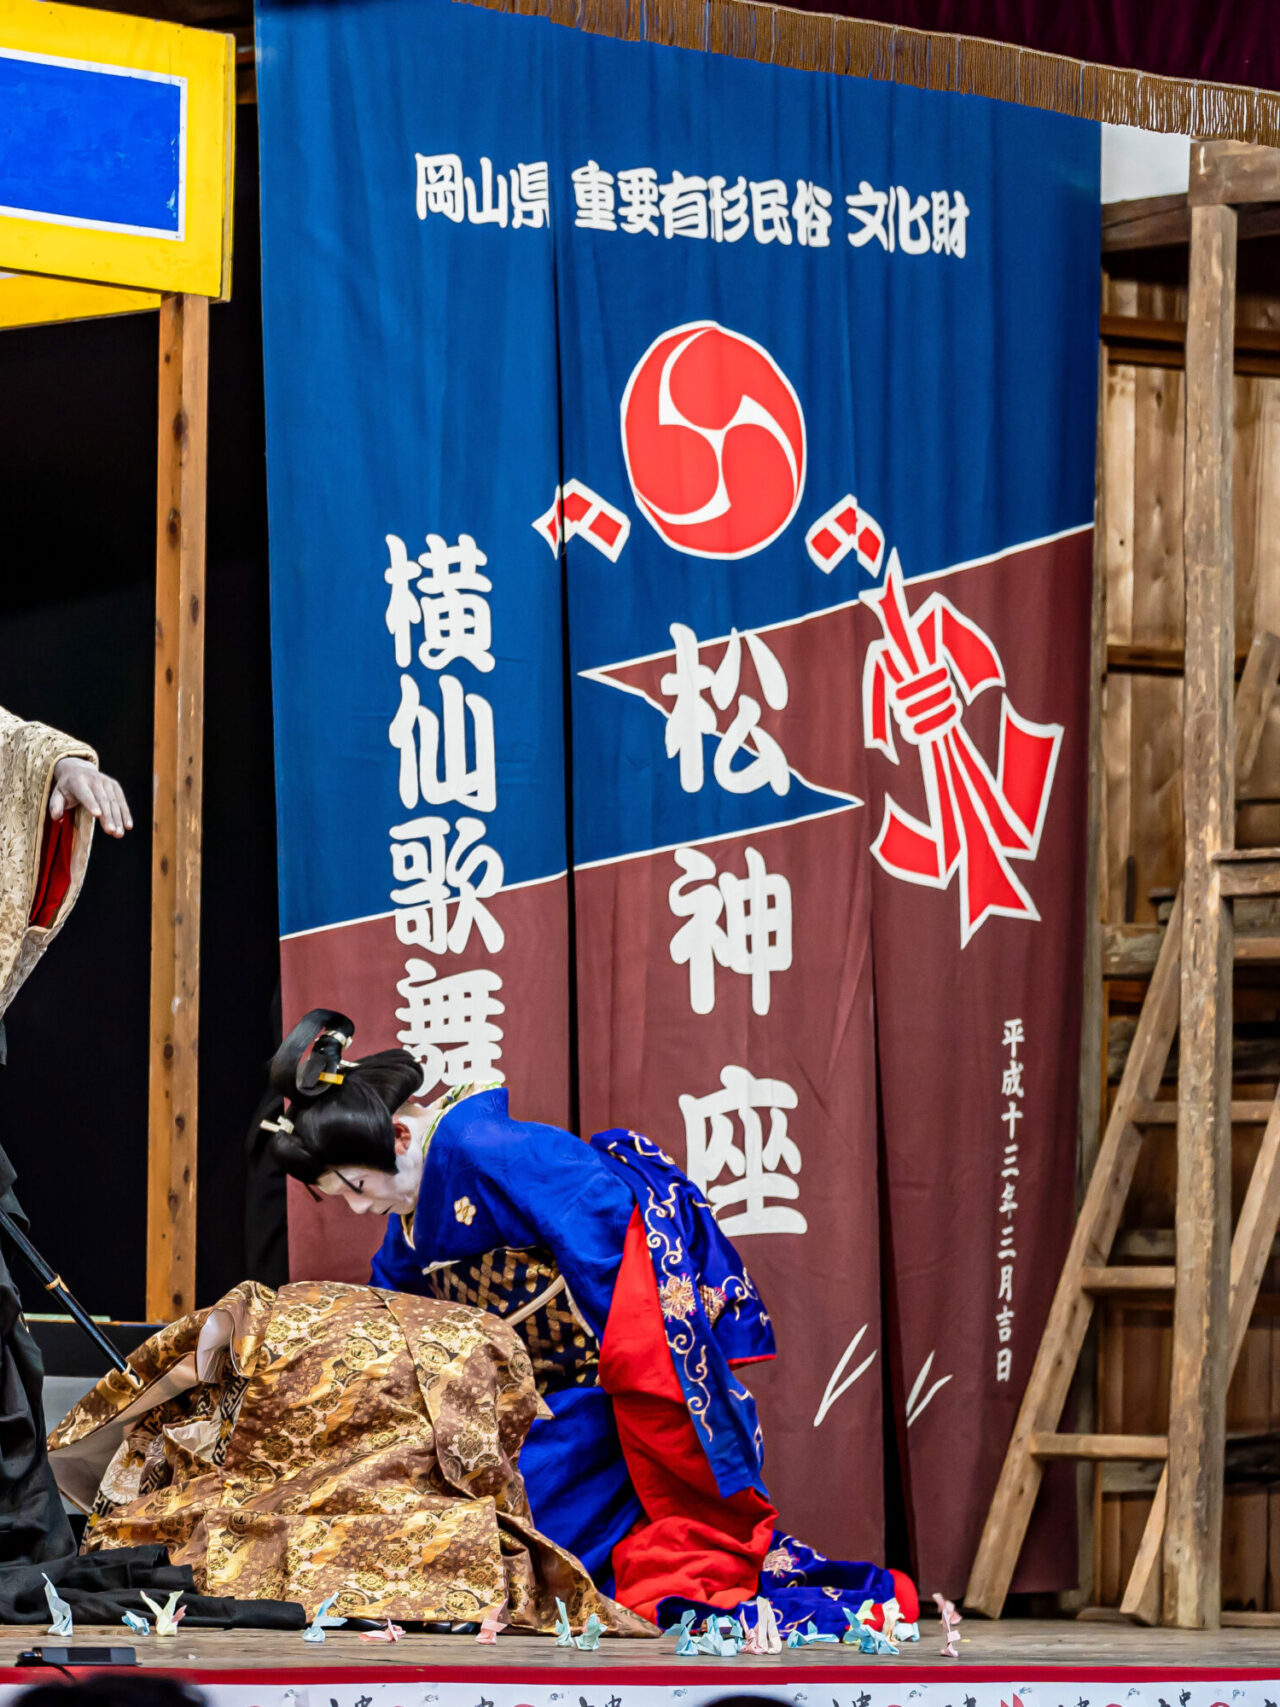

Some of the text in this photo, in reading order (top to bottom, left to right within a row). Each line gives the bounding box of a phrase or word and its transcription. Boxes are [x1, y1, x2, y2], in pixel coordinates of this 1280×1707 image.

[415, 153, 969, 258] 岡山県 重要有形民俗 文化財
[385, 533, 505, 1098] 横仙歌舞
[660, 622, 808, 1237] 松神座
